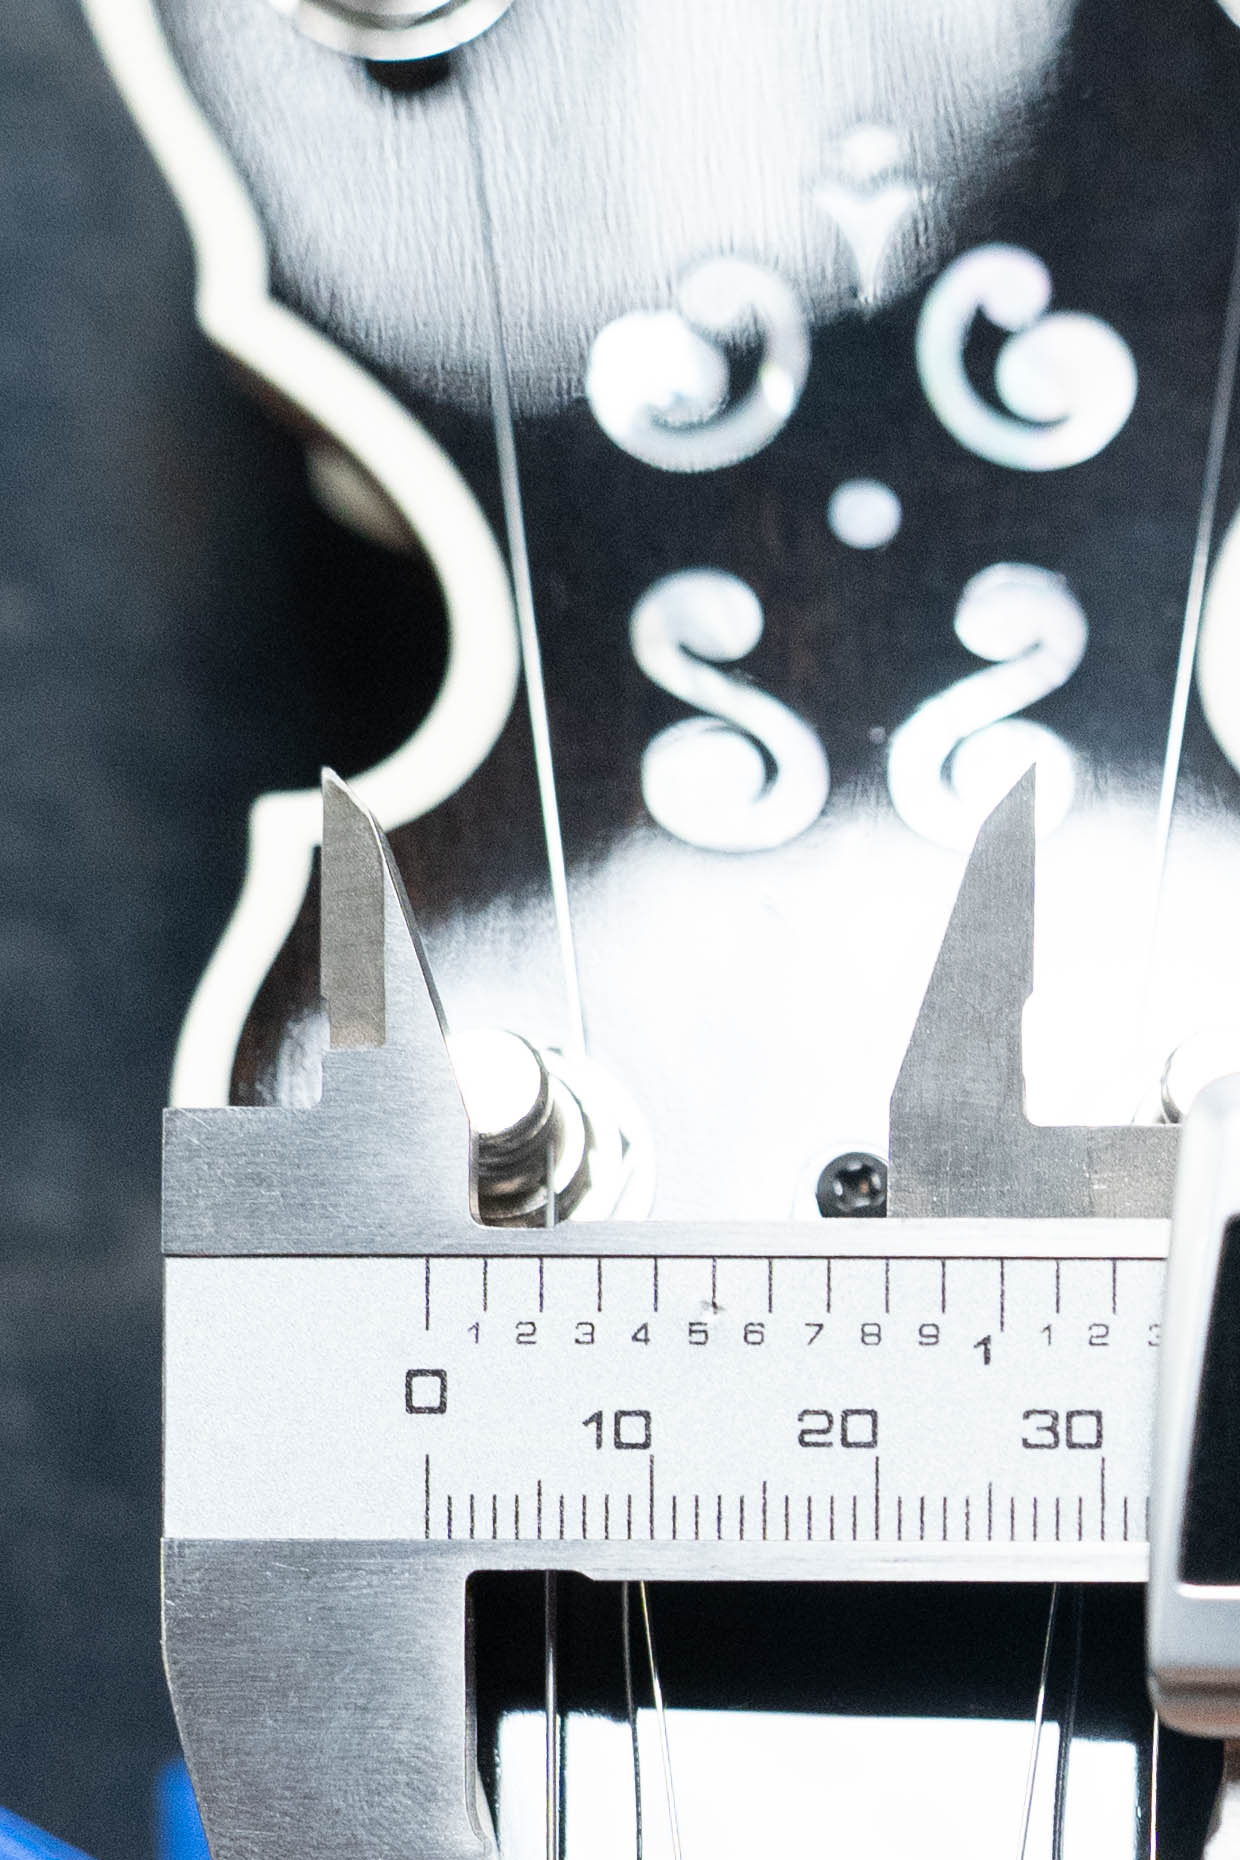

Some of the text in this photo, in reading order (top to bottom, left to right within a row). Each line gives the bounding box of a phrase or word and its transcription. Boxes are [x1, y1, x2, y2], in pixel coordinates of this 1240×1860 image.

[467, 1321, 480, 1345] 1
[514, 1320, 538, 1346] 2
[573, 1321, 596, 1346] 3
[630, 1321, 651, 1346] 4
[687, 1321, 710, 1347] 5
[742, 1321, 766, 1347] 6
[804, 1321, 825, 1346] 7
[860, 1321, 883, 1347] 8
[917, 1321, 941, 1347] 9
[972, 1334, 992, 1366] 1
[1040, 1322, 1053, 1347] 1
[1087, 1321, 1111, 1347] 2
[404, 1368, 1104, 1451] 0 10 20 30
